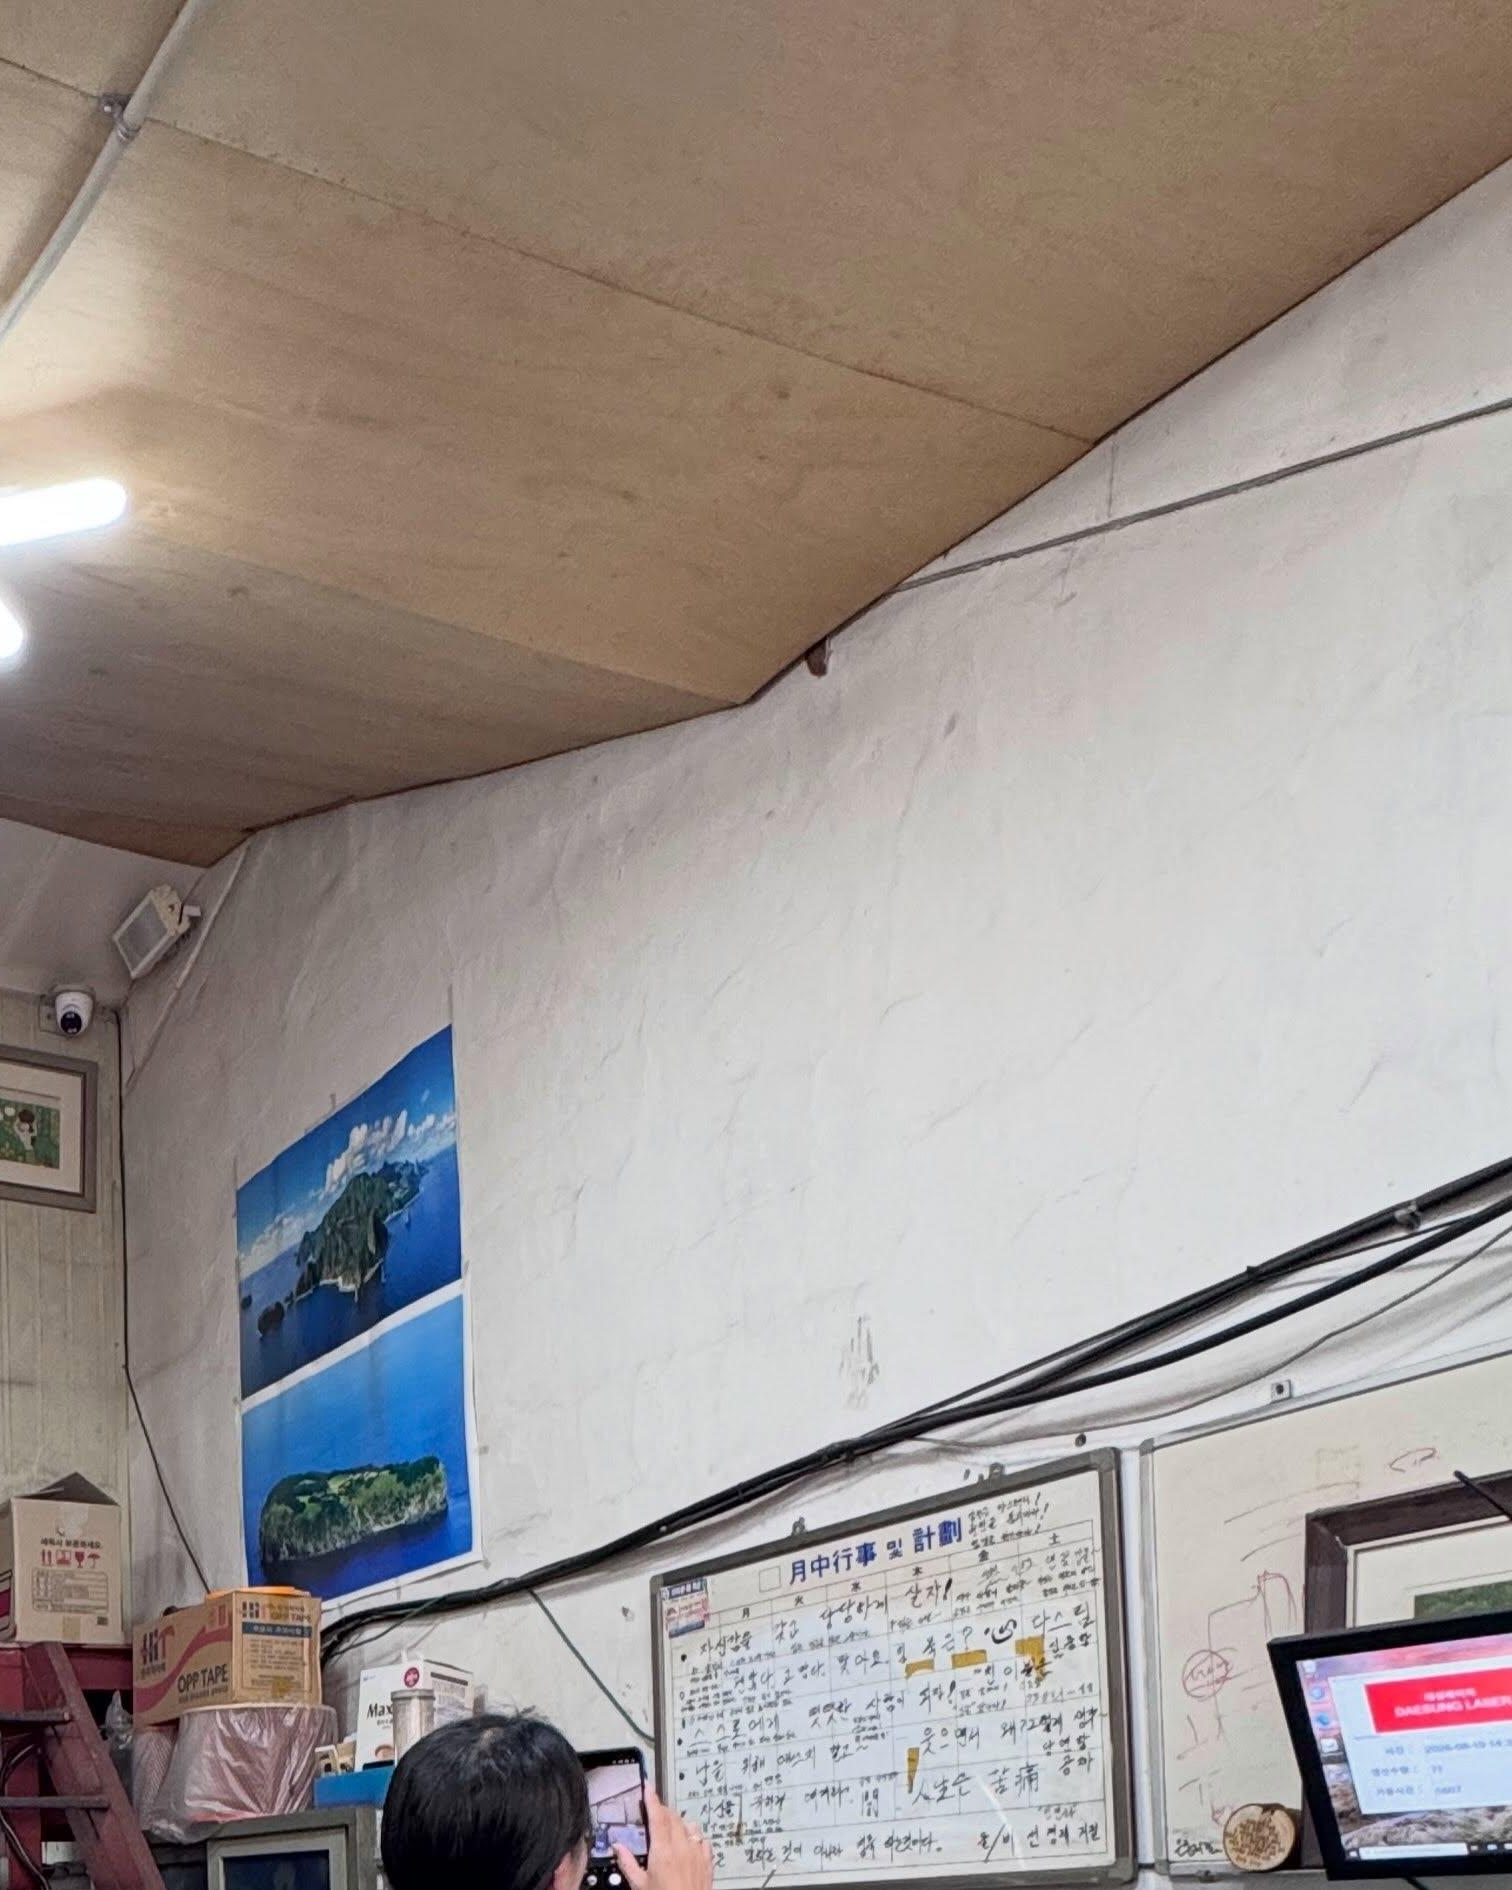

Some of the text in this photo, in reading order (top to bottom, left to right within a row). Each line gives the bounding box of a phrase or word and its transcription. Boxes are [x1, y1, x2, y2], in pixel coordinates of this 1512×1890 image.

[789, 1541, 878, 1585] 月中行事
[887, 1538, 903, 1560] 및
[177, 1671, 201, 1693] OPP
[201, 1663, 229, 1686] TAPE
